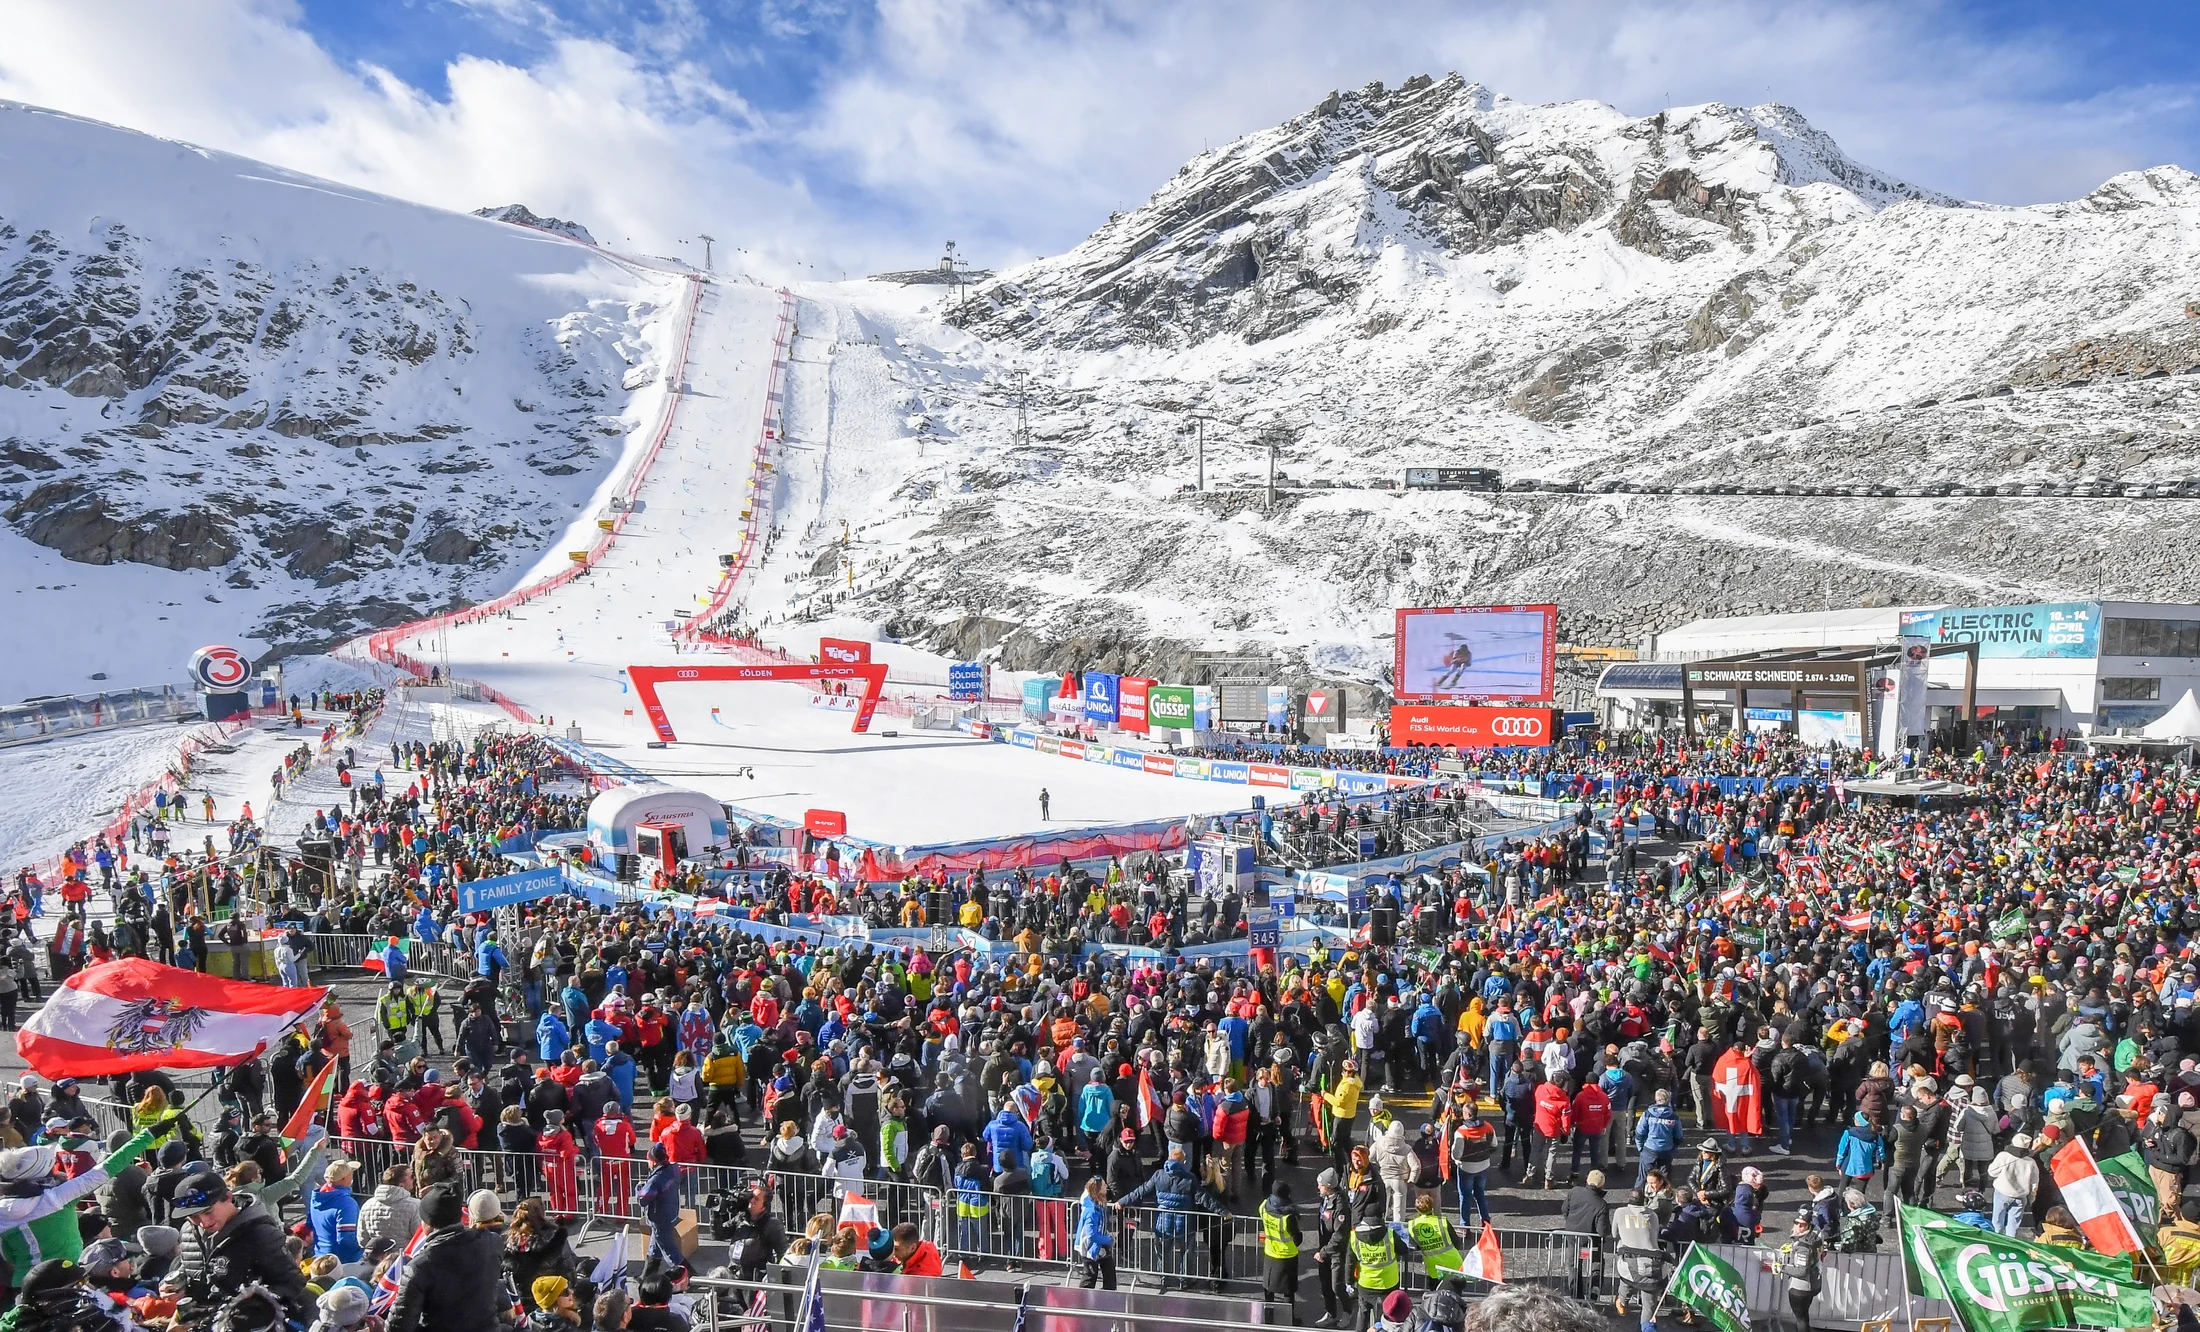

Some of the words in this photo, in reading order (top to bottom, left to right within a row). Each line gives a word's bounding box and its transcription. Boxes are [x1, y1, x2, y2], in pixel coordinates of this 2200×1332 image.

[1941, 612, 2034, 630] ELECTRIC
[2049, 611, 2064, 621] 10.
[2074, 611, 2089, 620] 14.
[2048, 622, 2085, 633] APRIL
[1941, 629, 2043, 643] MOUNTAIN
[2048, 633, 2085, 644] 2023
[825, 646, 860, 662] Tirol
[739, 668, 773, 677] SÖLDEN
[810, 666, 854, 675] e-tron
[950, 671, 982, 679] SÖLDEN
[1704, 671, 1752, 681] SCHWARZE
[1754, 671, 1803, 682] SCHNEIDE
[1805, 674, 1823, 682] 2.674
[1830, 674, 1855, 682] 3.247m
[950, 681, 982, 689] SÖLDEN
[1120, 691, 1145, 705] Kronen
[1086, 701, 1114, 714] UNIQA
[1150, 694, 1190, 719] Gösser
[1120, 705, 1145, 720] Zeitung
[1437, 725, 1461, 733] World
[1462, 726, 1477, 734] Cup
[1223, 770, 1247, 781] UNIQA
[1352, 781, 1383, 792] UNQA
[660, 811, 694, 820] AUSTRIA
[480, 881, 522, 901] FAMILY
[524, 875, 557, 892] ZONE
[1279, 903, 1285, 915] 5
[1355, 898, 1360, 909] 3
[1994, 1010, 2015, 1020] USA
[2115, 1190, 2155, 1225] ser
[1688, 1264, 1751, 1330] Gösse
